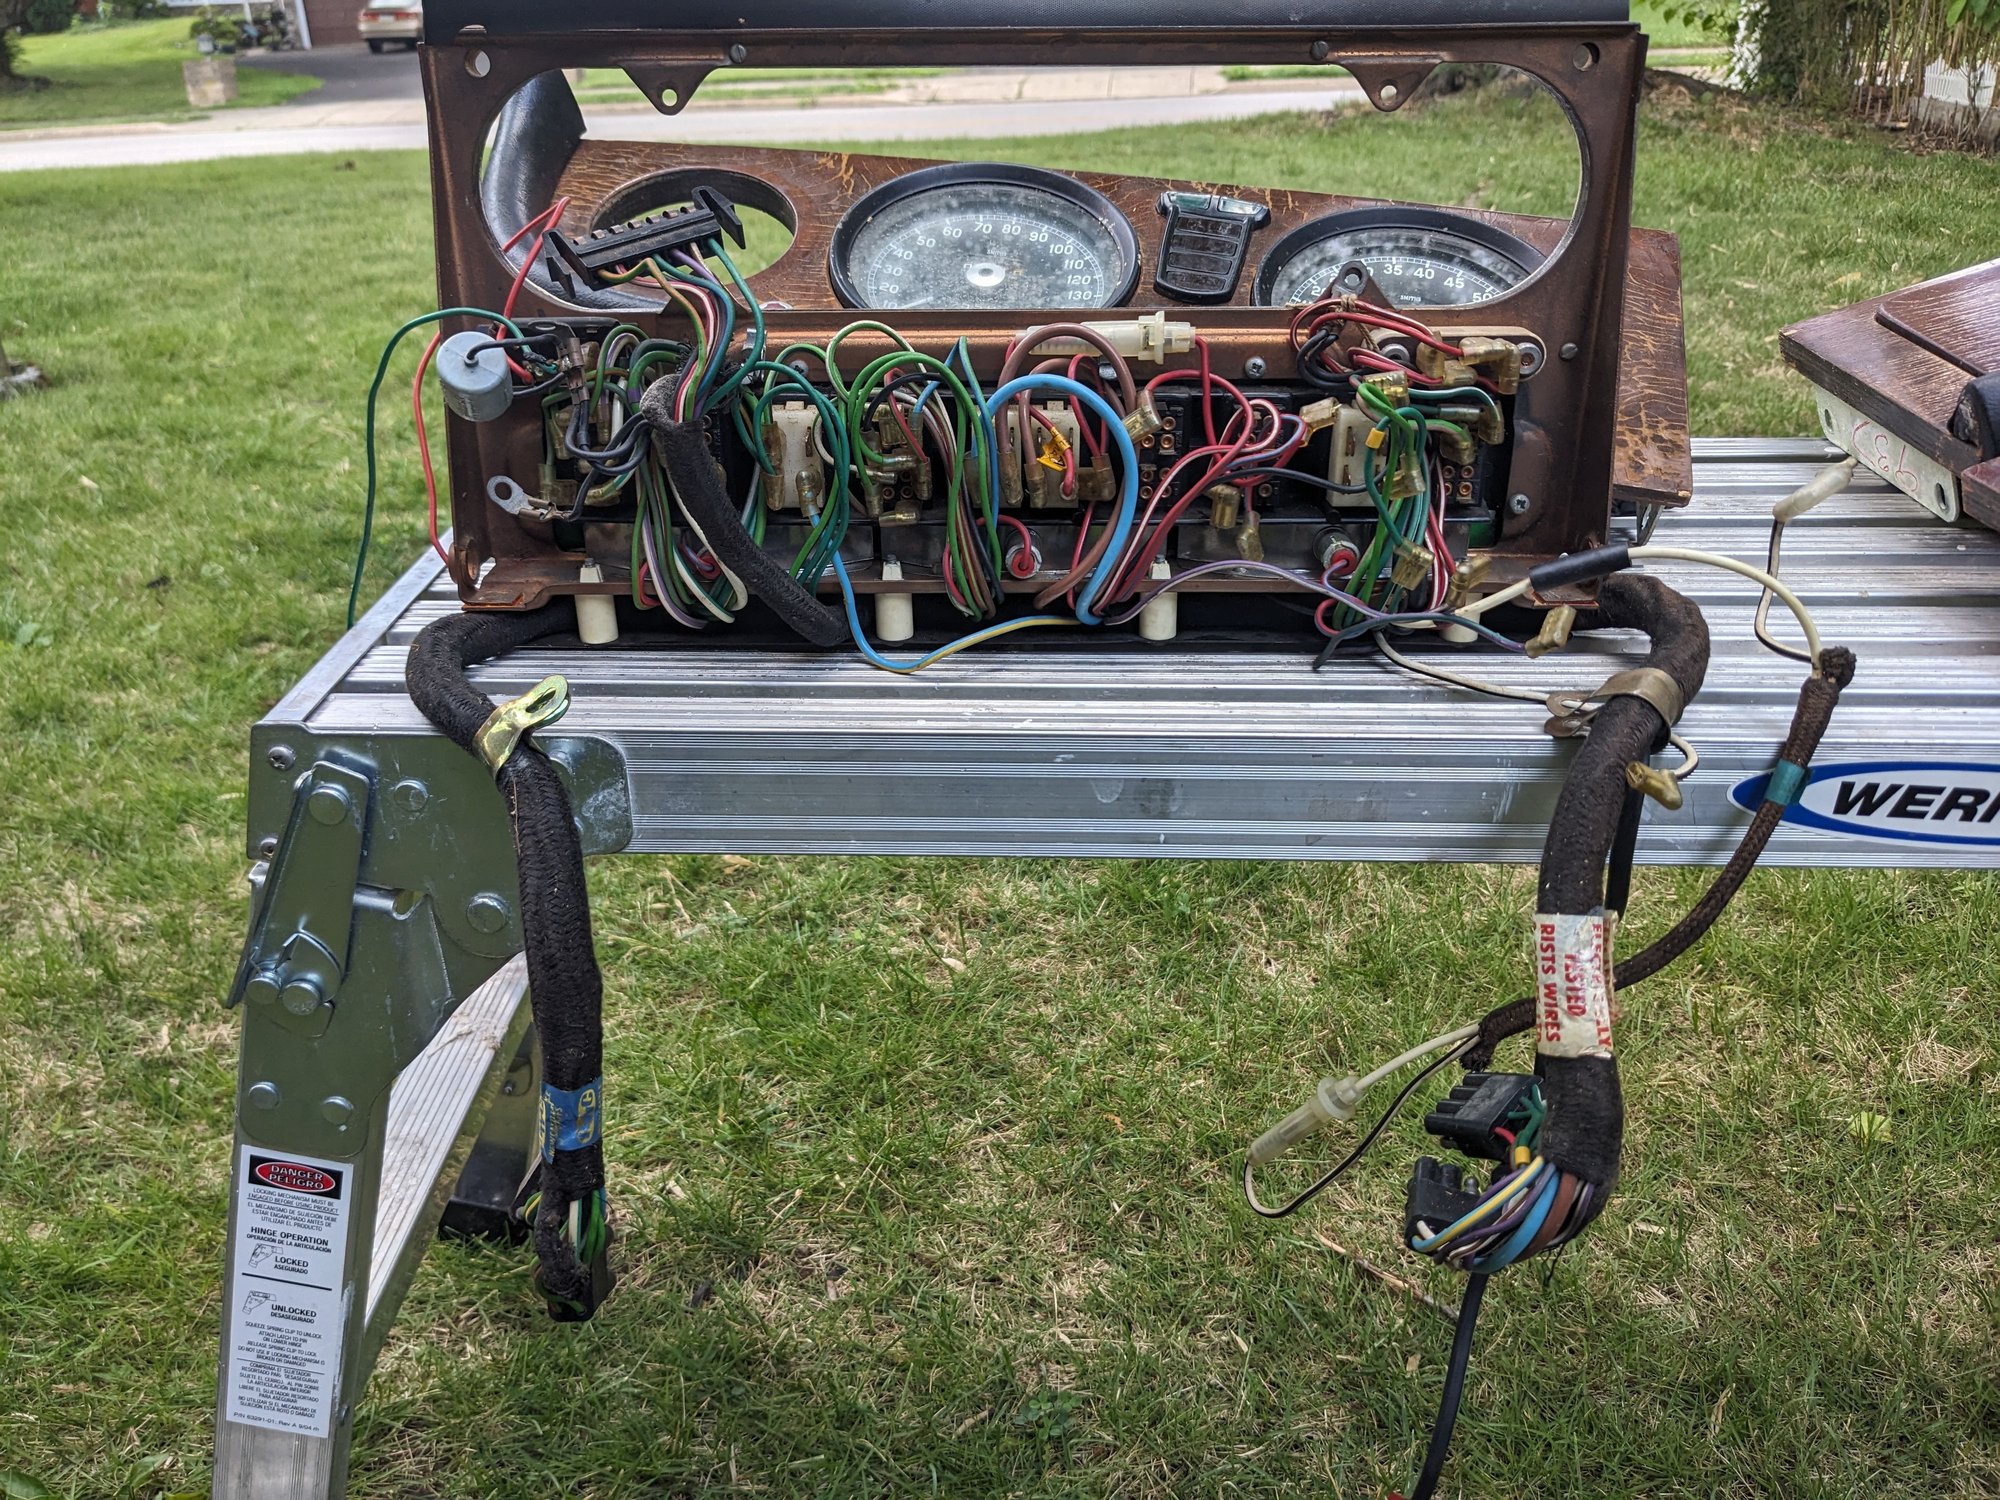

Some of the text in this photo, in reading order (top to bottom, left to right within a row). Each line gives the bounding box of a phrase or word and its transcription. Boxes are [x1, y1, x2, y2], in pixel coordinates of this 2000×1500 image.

[942, 226, 962, 239] 60
[973, 221, 992, 235] 70
[1001, 223, 1021, 236] 80
[916, 235, 936, 248] 50
[1029, 231, 1048, 243] 90
[893, 248, 913, 261] 40
[1049, 243, 1073, 255] 100
[883, 264, 903, 277] 30
[1063, 259, 1084, 270] 110
[1383, 263, 1403, 276] 35
[1066, 274, 1091, 286] 120
[1413, 267, 1435, 280] 40
[879, 282, 899, 294] 20
[1444, 276, 1464, 290] 45
[1067, 290, 1092, 301] 130
[1311, 286, 1326, 297] 2
[1472, 292, 1493, 303] 50
[1540, 923, 1561, 1043] RISTS WIRES
[271, 1165, 323, 1180] DANGER
[269, 1173, 323, 1189] PELIGRO
[253, 1187, 276, 1196] LOCKING
[277, 1192, 310, 1202] MECHANISM
[248, 1193, 338, 1213] ENGAGED BEFORE USING PRODUCT
[255, 1203, 288, 1213] MECANISMO
[252, 1208, 269, 1216] ESTAR
[270, 1211, 306, 1222] ENGANCHADO
[307, 1218, 324, 1226] ANTES
[261, 1216, 285, 1225] UTILIZAR
[293, 1222, 322, 1231] PRODUCTO
[251, 1226, 328, 1246] HINGE OPERATION
[275, 1255, 309, 1267] LOCKED
[274, 1263, 308, 1274] ASEGURADO
[271, 1303, 317, 1317] UNLOCKED
[270, 1312, 314, 1324] DESASEGURADO
[245, 1321, 265, 1329] SQUEEZE
[303, 1331, 322, 1339] UNLOCK
[258, 1330, 276, 1338] ATTACH
[247, 1340, 267, 1348] RELEASE
[271, 1351, 291, 1359] LOCKING
